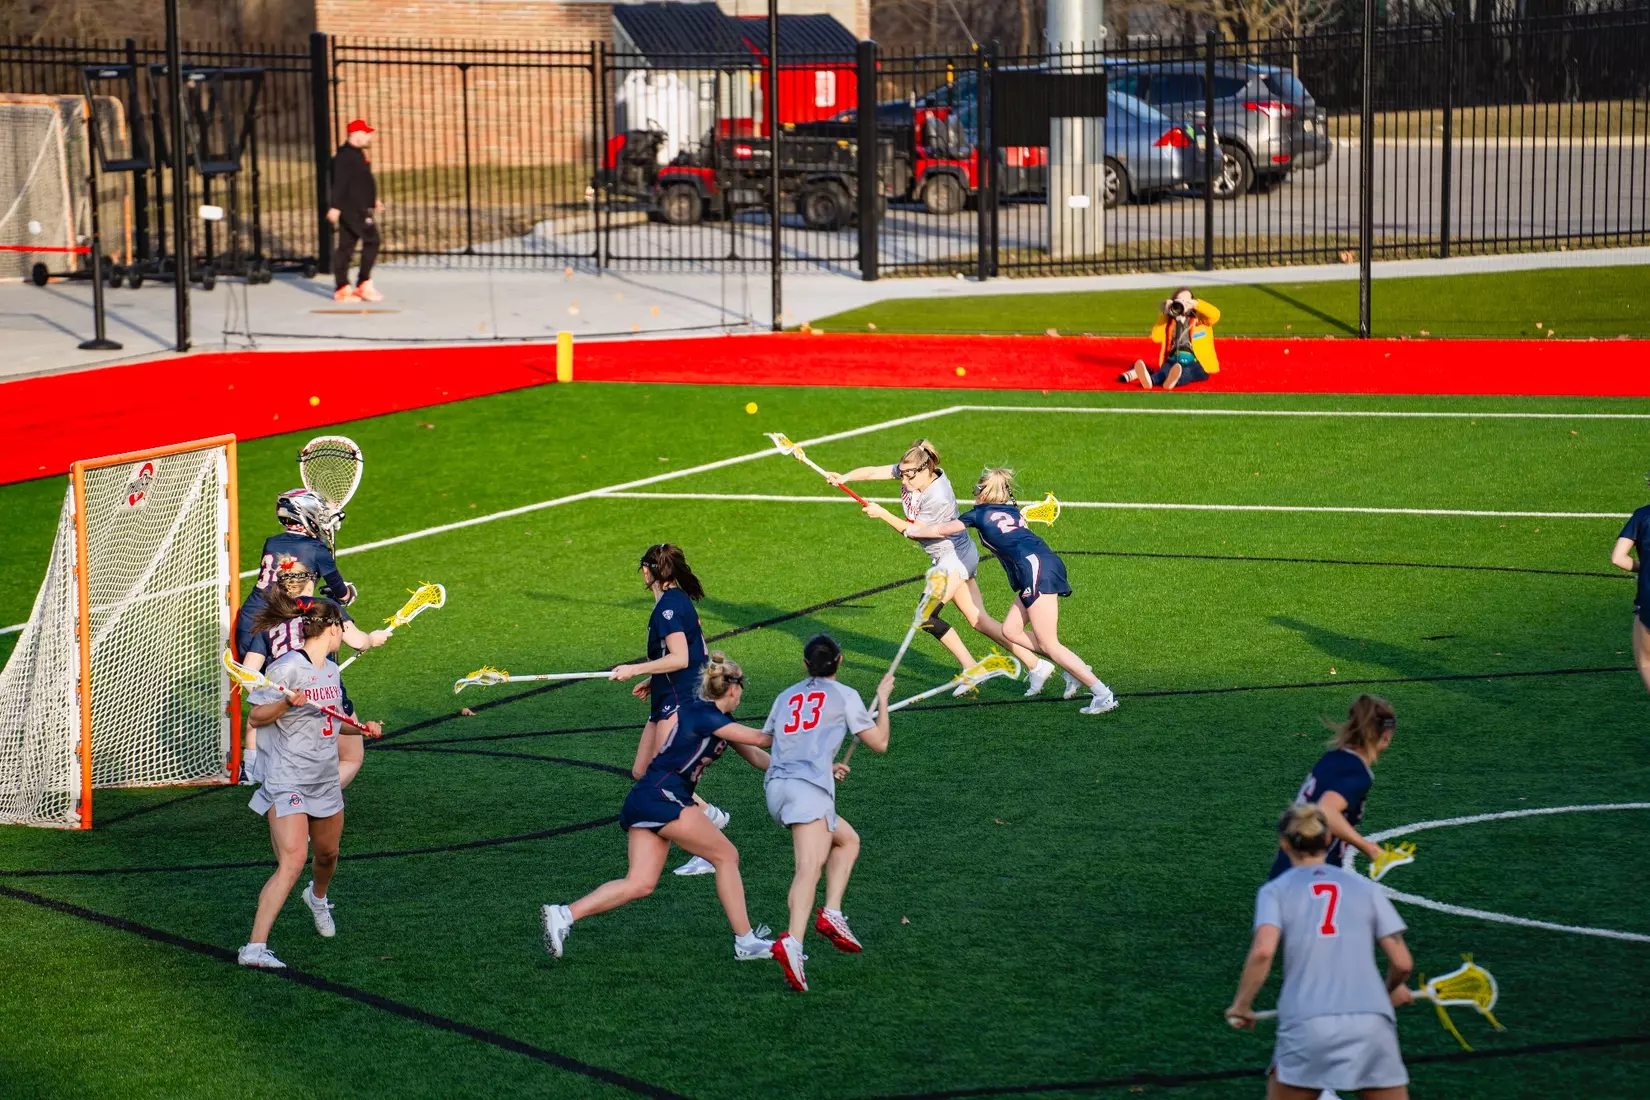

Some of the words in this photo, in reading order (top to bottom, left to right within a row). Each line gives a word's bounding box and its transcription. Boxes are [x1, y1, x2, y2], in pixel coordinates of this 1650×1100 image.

[321, 704, 337, 738] 3
[783, 691, 826, 736] 33
[1311, 882, 1341, 937] 7
